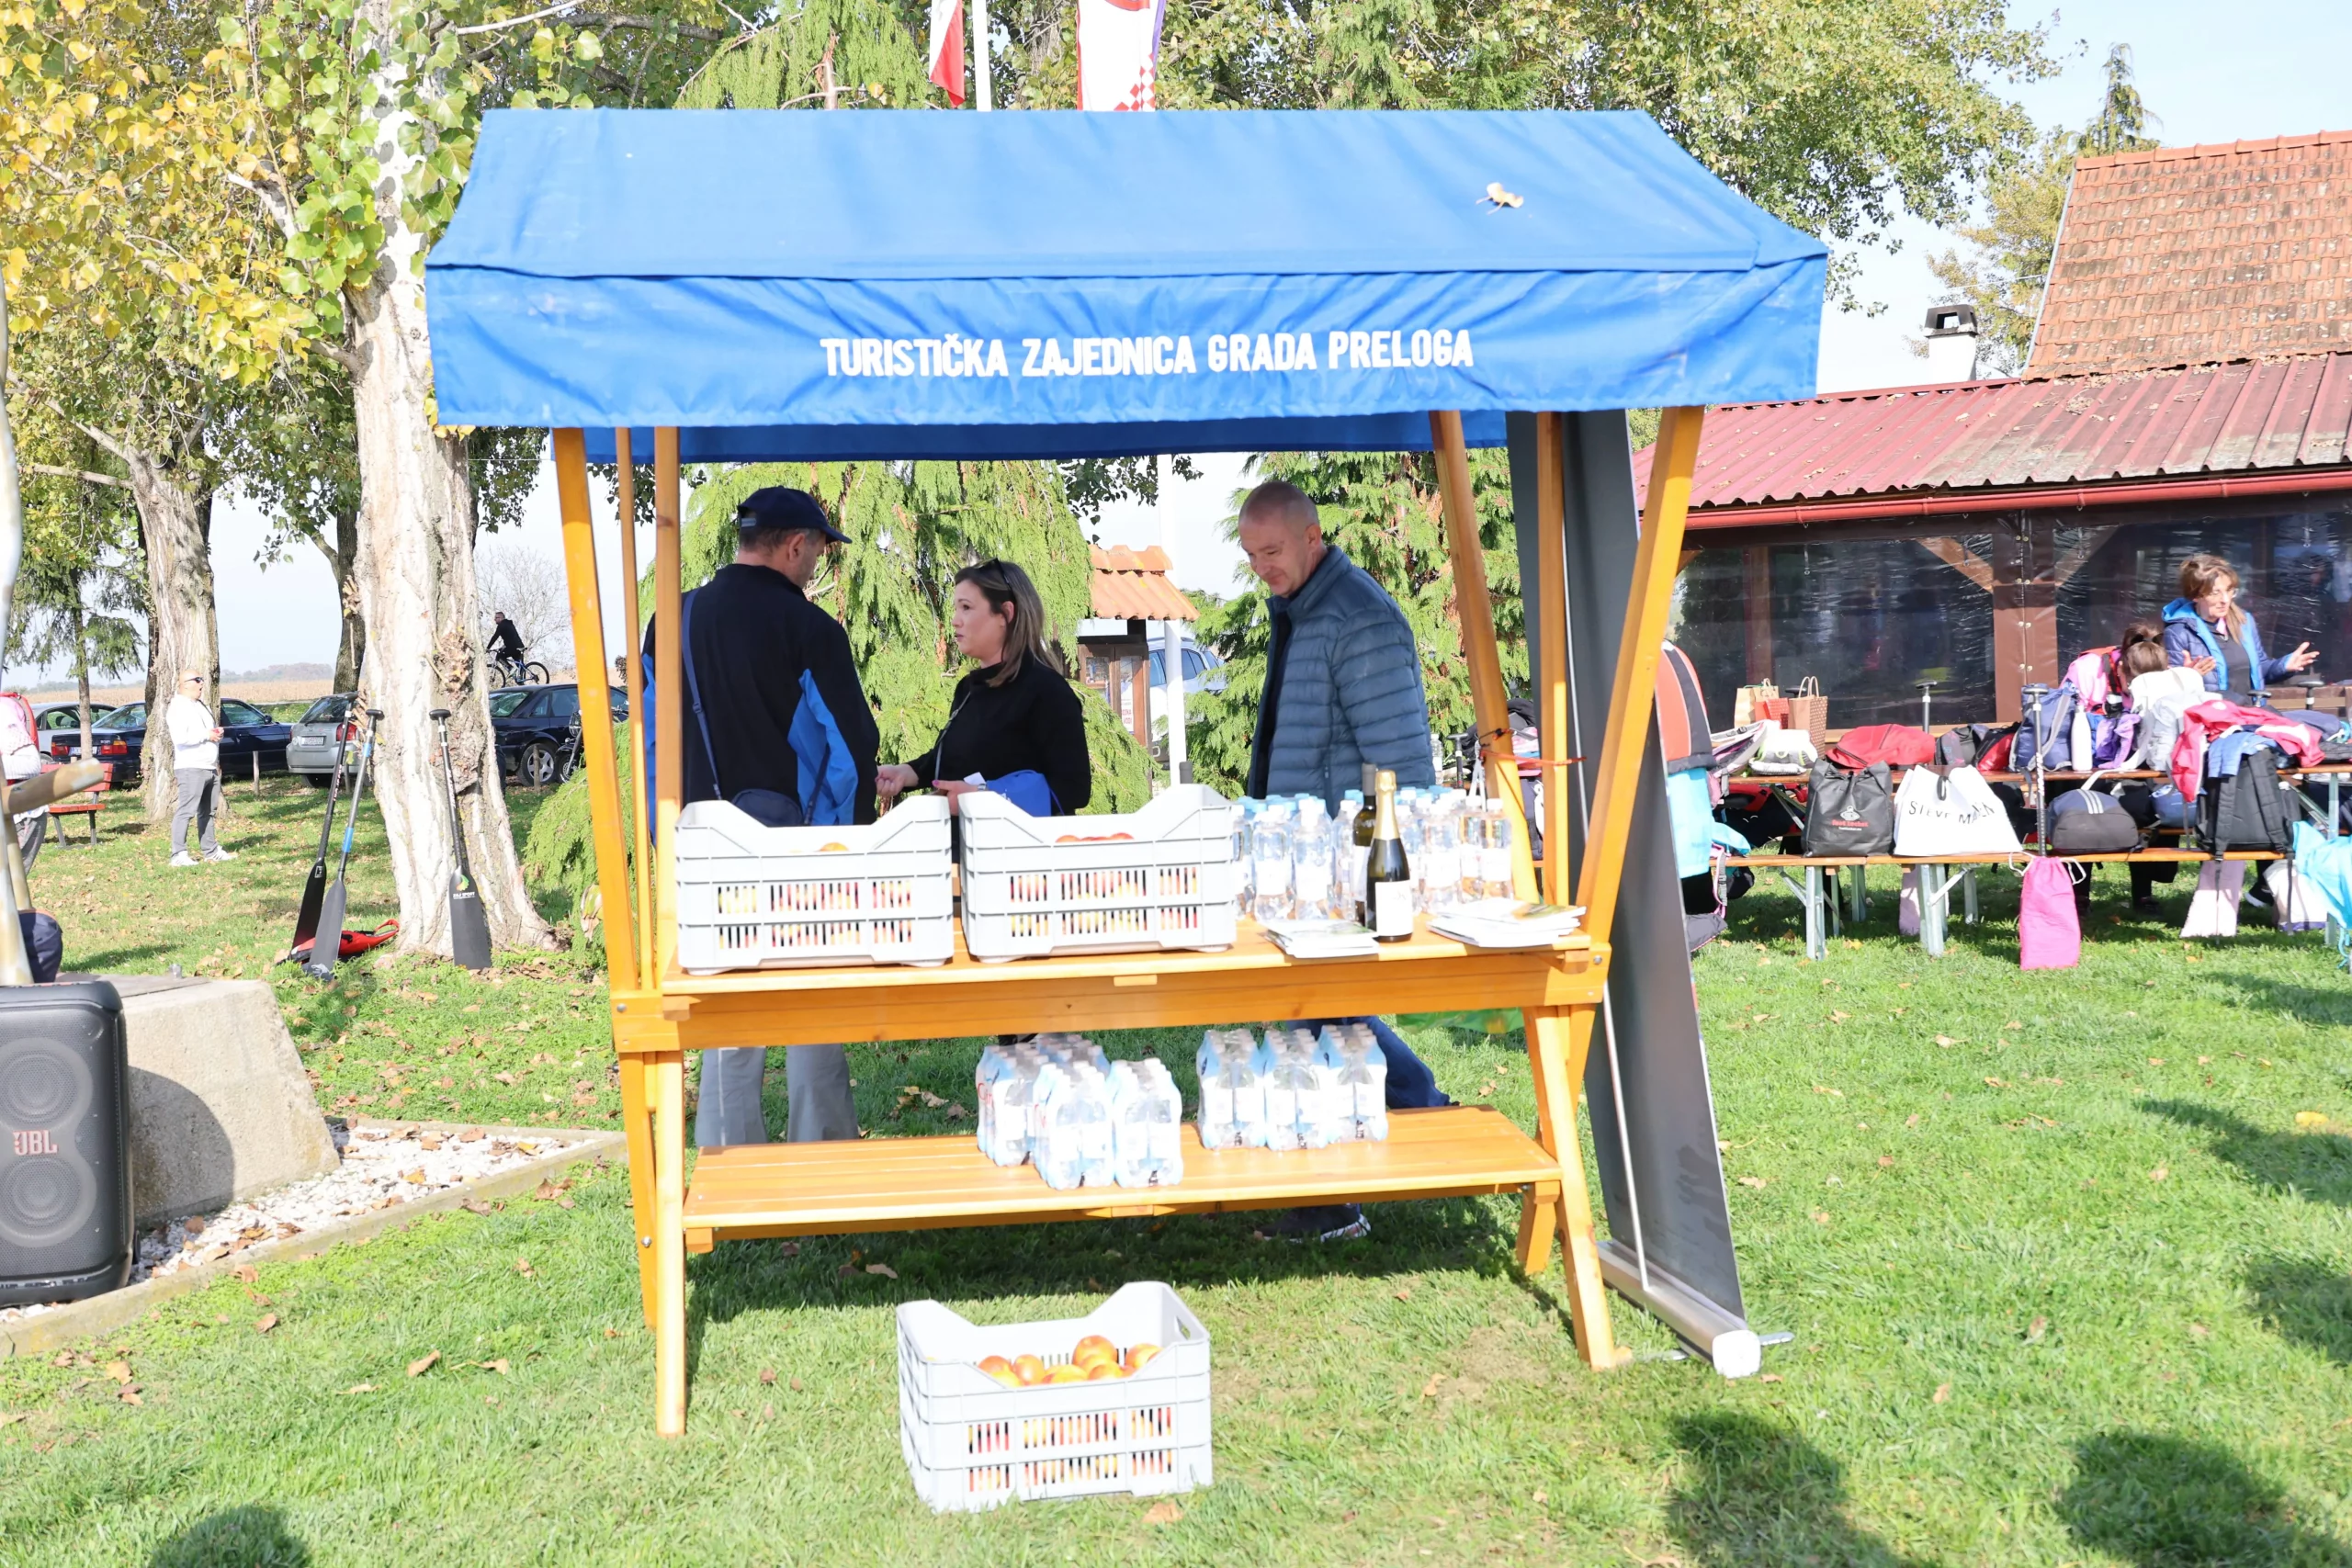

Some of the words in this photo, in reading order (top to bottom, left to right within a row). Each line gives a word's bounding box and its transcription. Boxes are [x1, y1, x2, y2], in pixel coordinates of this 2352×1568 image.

[820, 333, 1009, 377] TURISTIČKA
[1022, 335, 1197, 377] ZAJEDNICA
[1207, 333, 1317, 373] GRADA
[1329, 329, 1474, 369] PRELOGA
[12, 1130, 58, 1156] JBL
